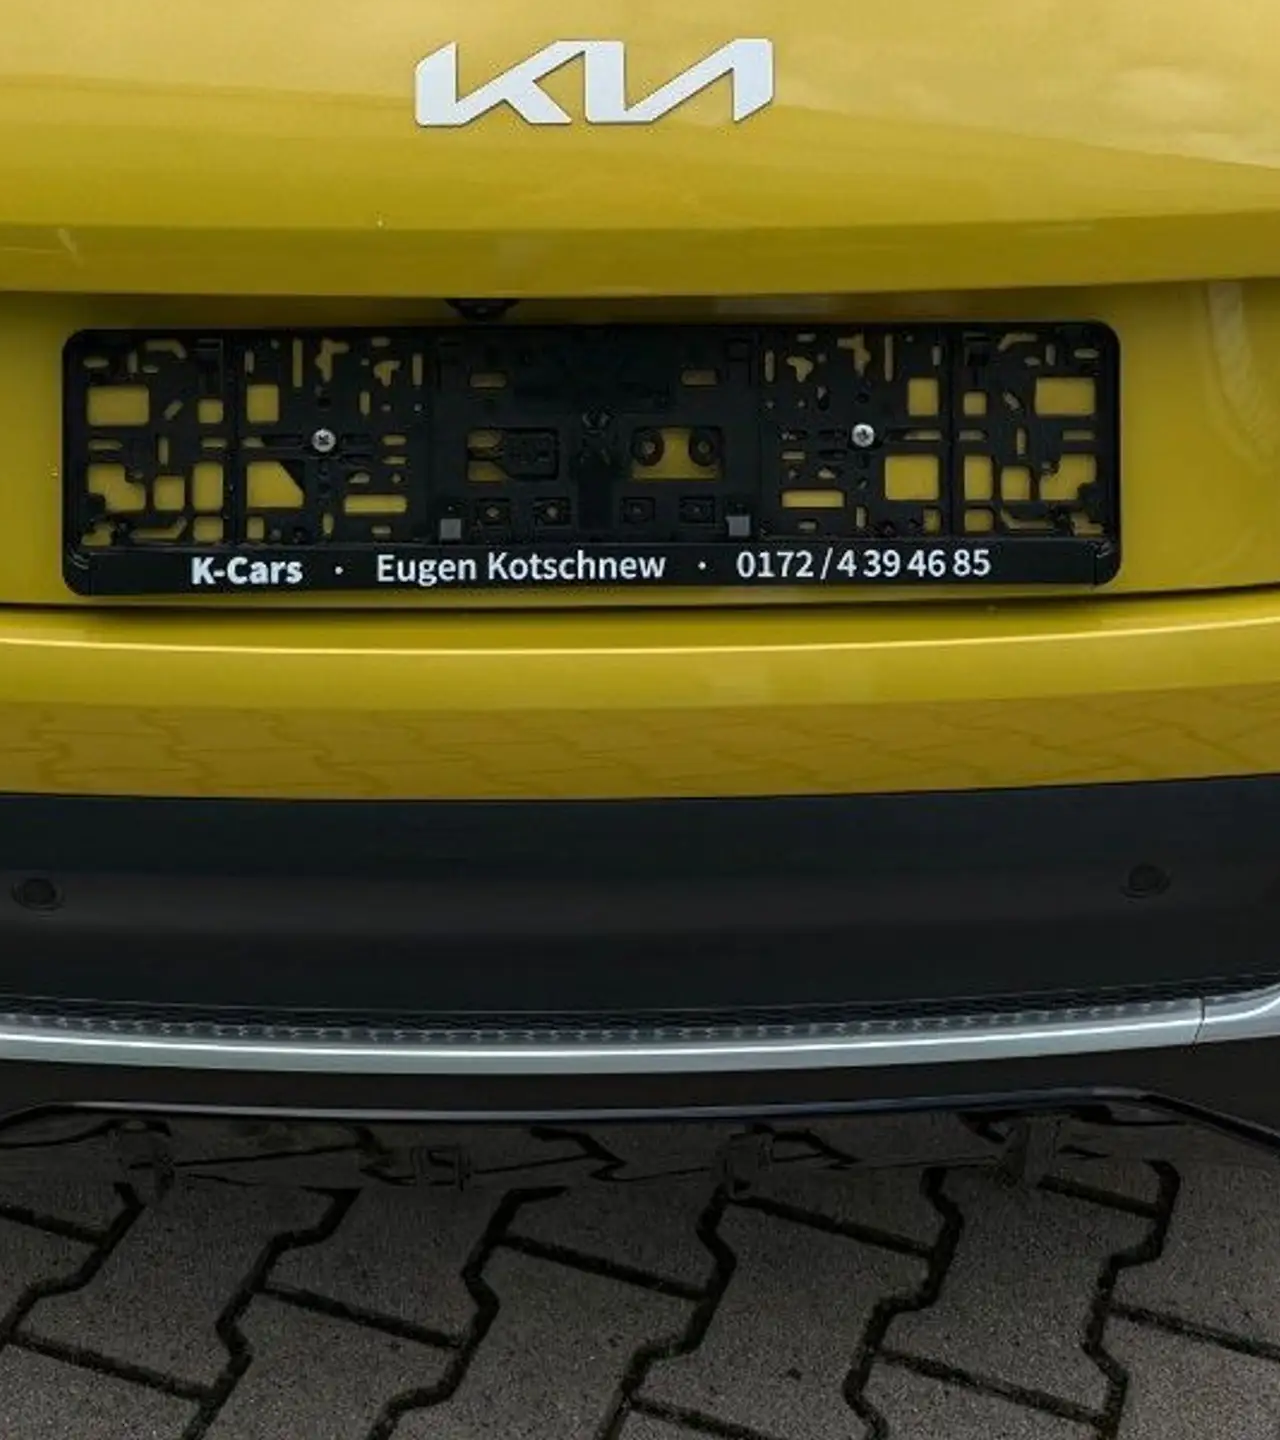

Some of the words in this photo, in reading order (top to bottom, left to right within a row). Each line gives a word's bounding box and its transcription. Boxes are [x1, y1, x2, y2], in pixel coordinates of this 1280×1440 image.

[415, 38, 774, 126] KIA
[191, 556, 303, 585] K-Cars
[377, 554, 477, 586] Eugen
[488, 550, 666, 581] Kotschnew
